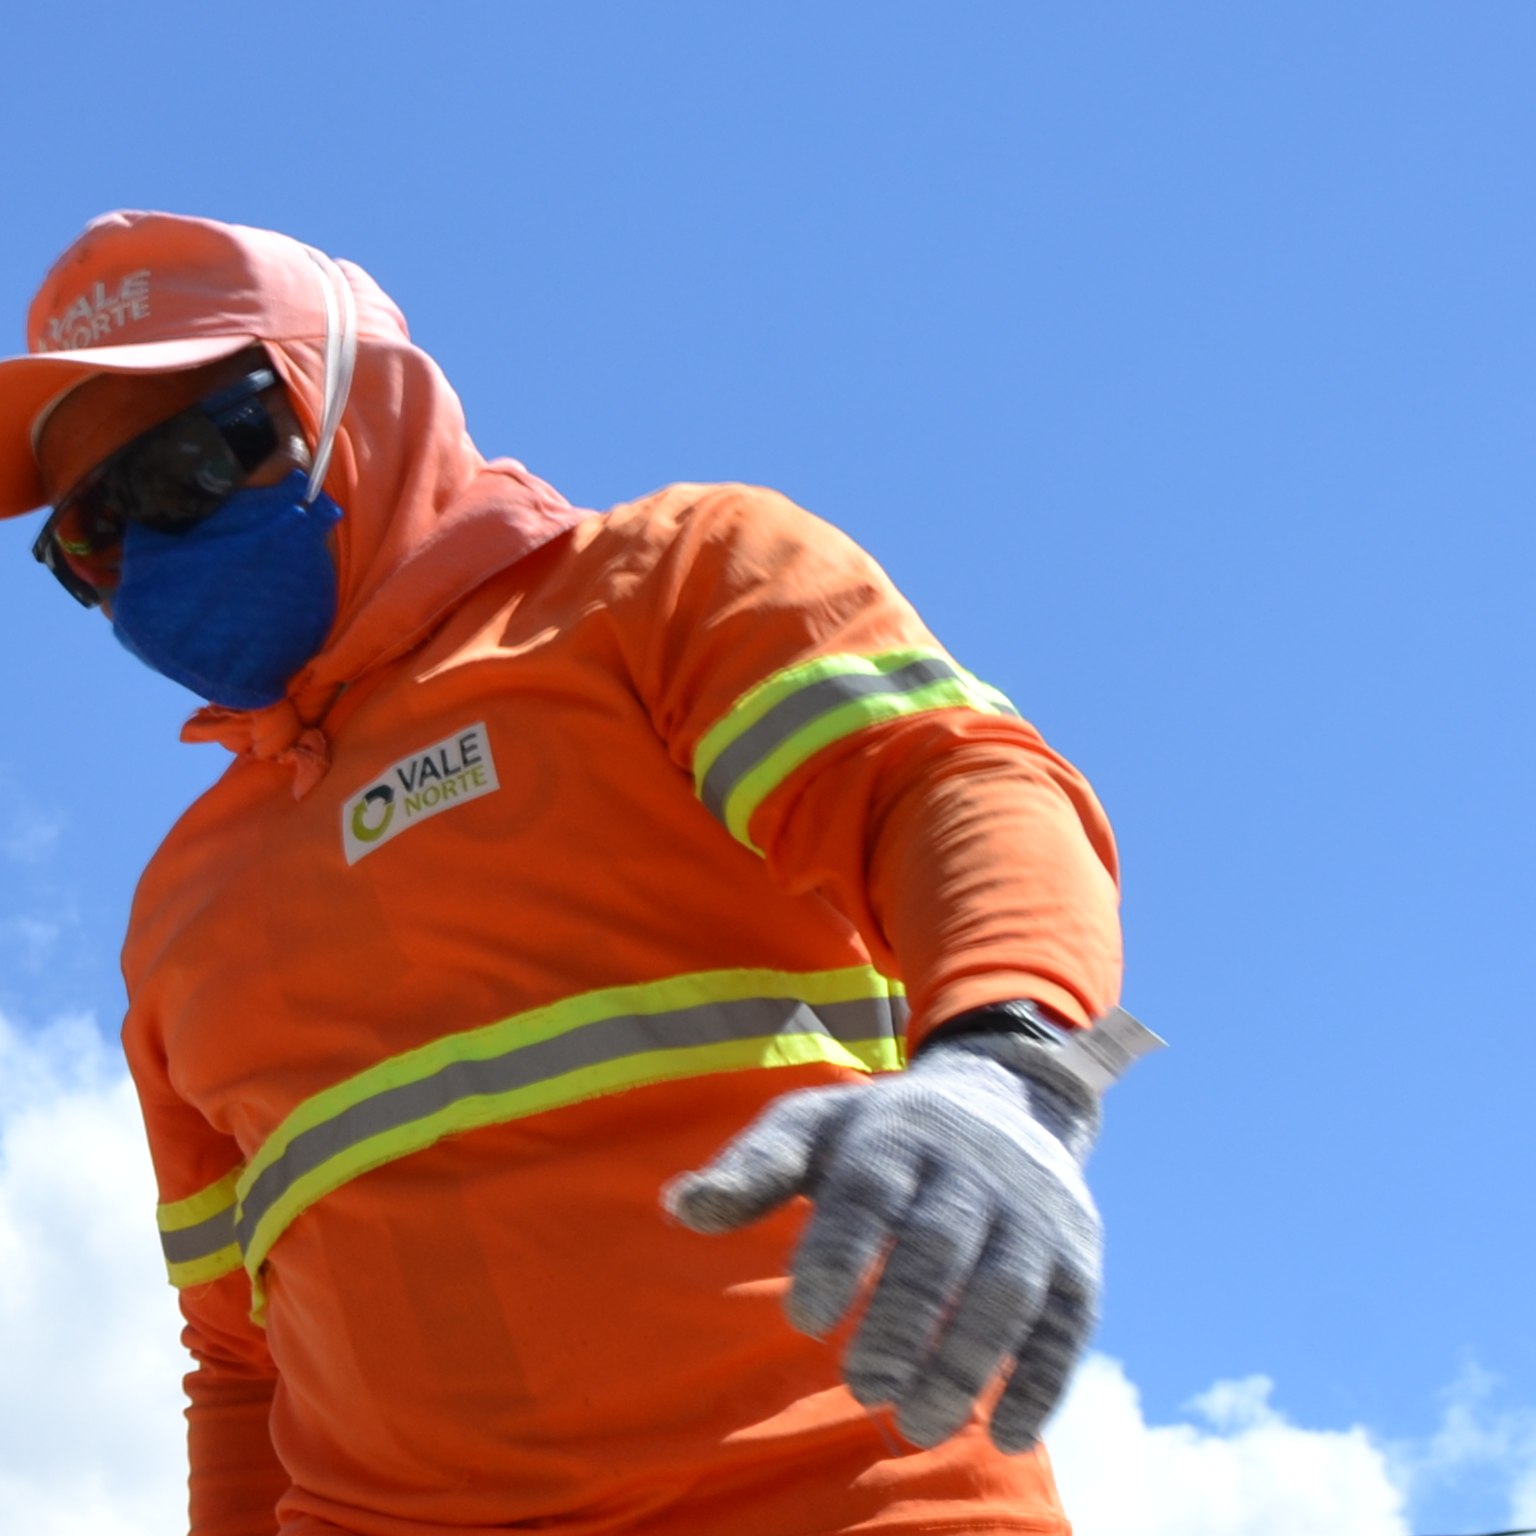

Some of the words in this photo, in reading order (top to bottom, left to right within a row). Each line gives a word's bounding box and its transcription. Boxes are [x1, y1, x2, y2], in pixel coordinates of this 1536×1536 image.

[48, 268, 151, 343] VALE
[396, 732, 482, 793] VALE
[402, 764, 488, 818] NORTE
